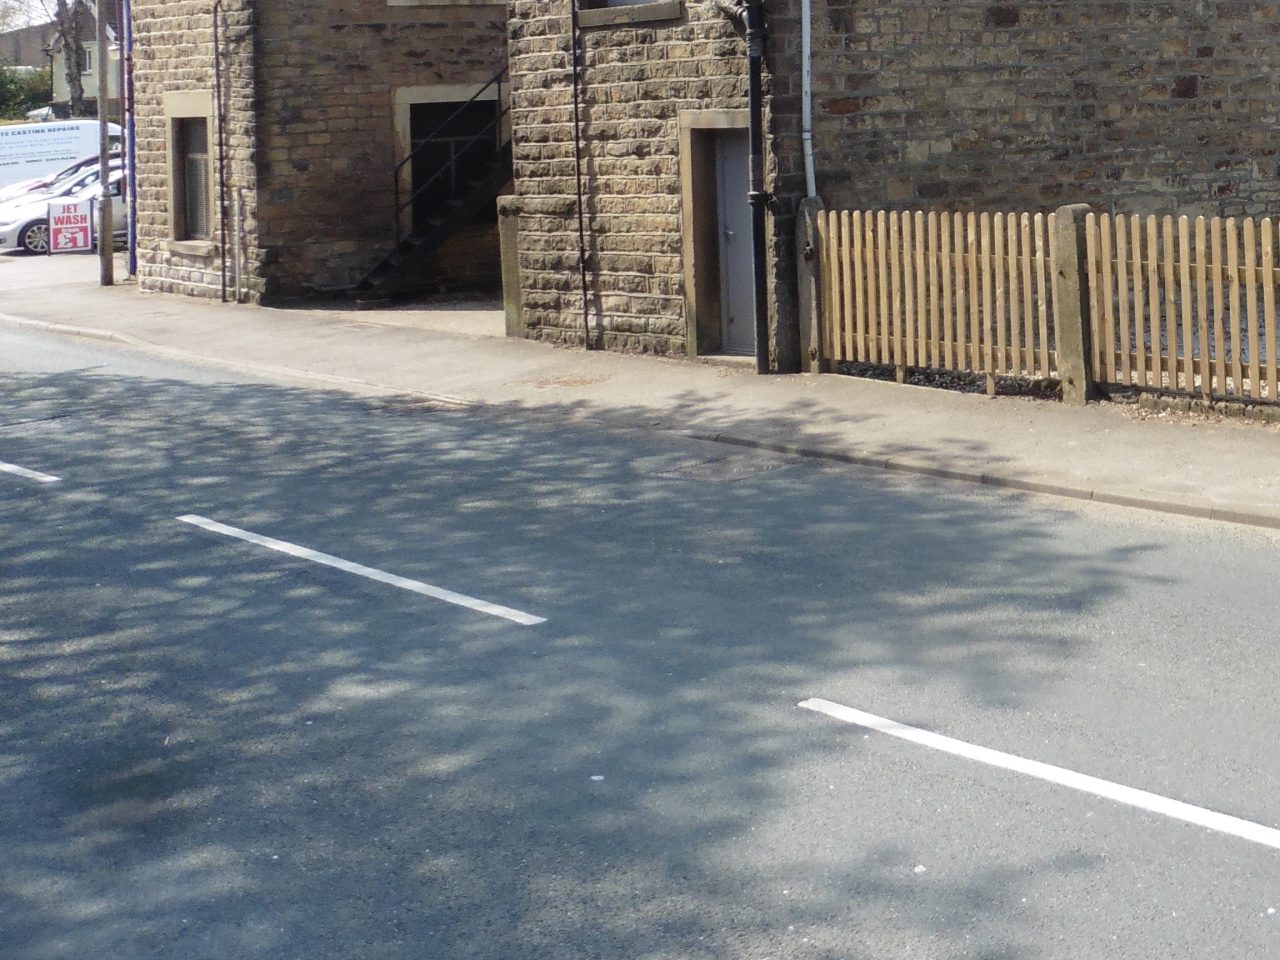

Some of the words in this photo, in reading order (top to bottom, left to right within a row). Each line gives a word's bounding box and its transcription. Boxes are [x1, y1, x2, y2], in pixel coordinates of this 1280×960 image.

[61, 204, 78, 214] JET
[53, 214, 87, 226] WASH
[58, 232, 84, 248] £1
